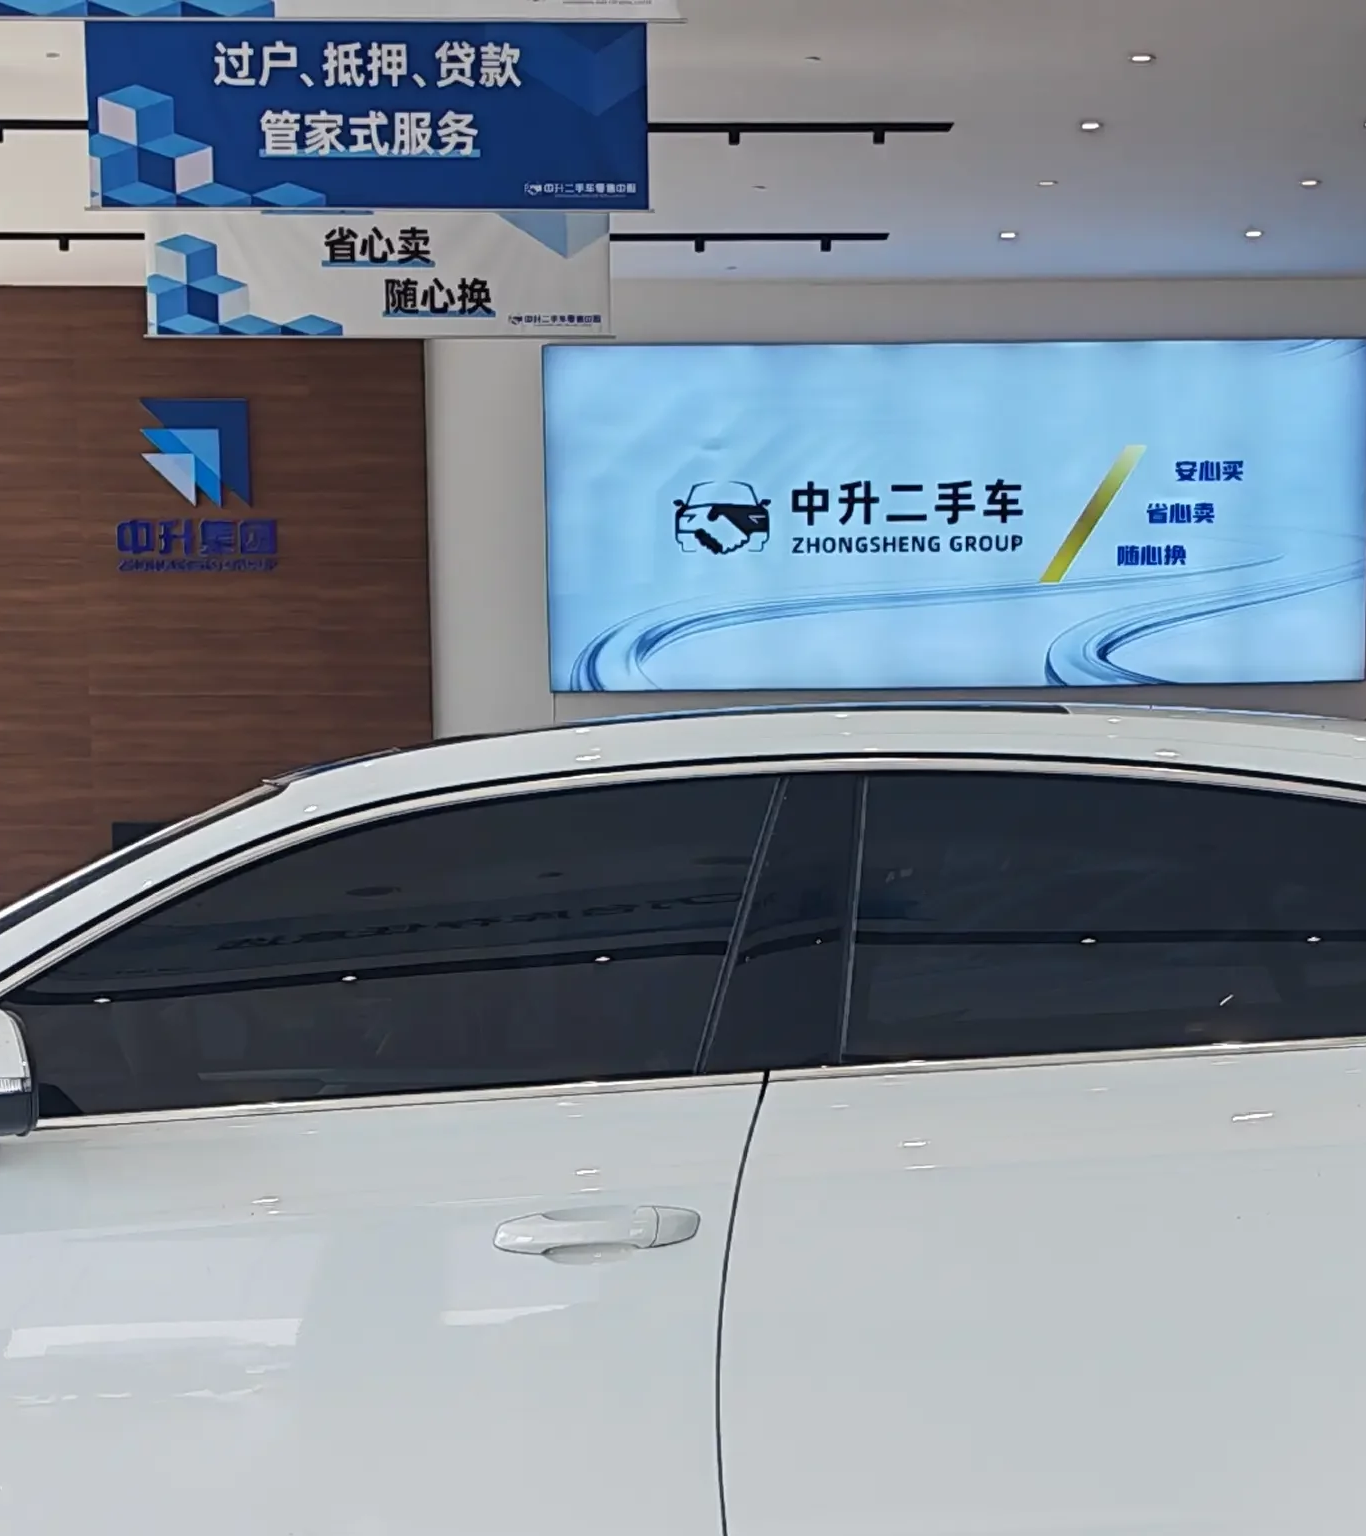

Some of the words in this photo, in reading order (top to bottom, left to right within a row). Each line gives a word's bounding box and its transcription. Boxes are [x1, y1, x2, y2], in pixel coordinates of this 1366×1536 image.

[213, 41, 522, 89] 过户、抵押、贷款
[259, 110, 479, 156] 管家式服务
[323, 228, 433, 264] 省心卖
[384, 278, 492, 316] 随心换
[1175, 460, 1244, 481] 安心买
[791, 479, 1024, 526] 中升二手车
[1146, 502, 1215, 524] 省心卖
[792, 536, 941, 554] ZHONGSHENG
[949, 534, 1023, 552] GROUP
[1117, 545, 1187, 566] 随心换
